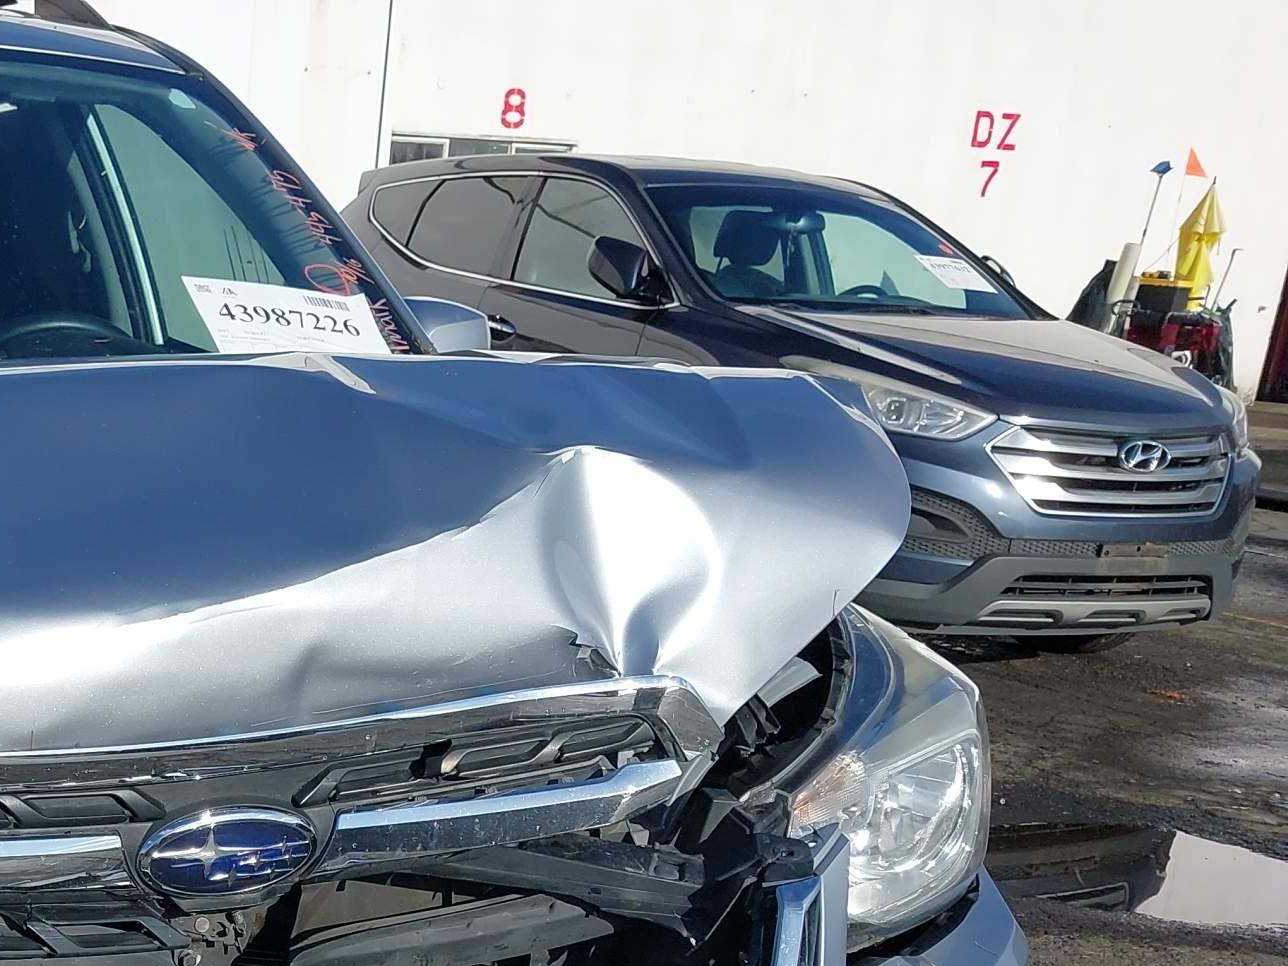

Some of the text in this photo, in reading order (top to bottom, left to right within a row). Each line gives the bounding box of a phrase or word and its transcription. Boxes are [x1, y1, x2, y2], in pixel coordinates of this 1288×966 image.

[501, 88, 526, 129] 8
[971, 110, 1021, 151] DZ
[980, 160, 1000, 198] 7
[218, 302, 361, 337] 43987226
